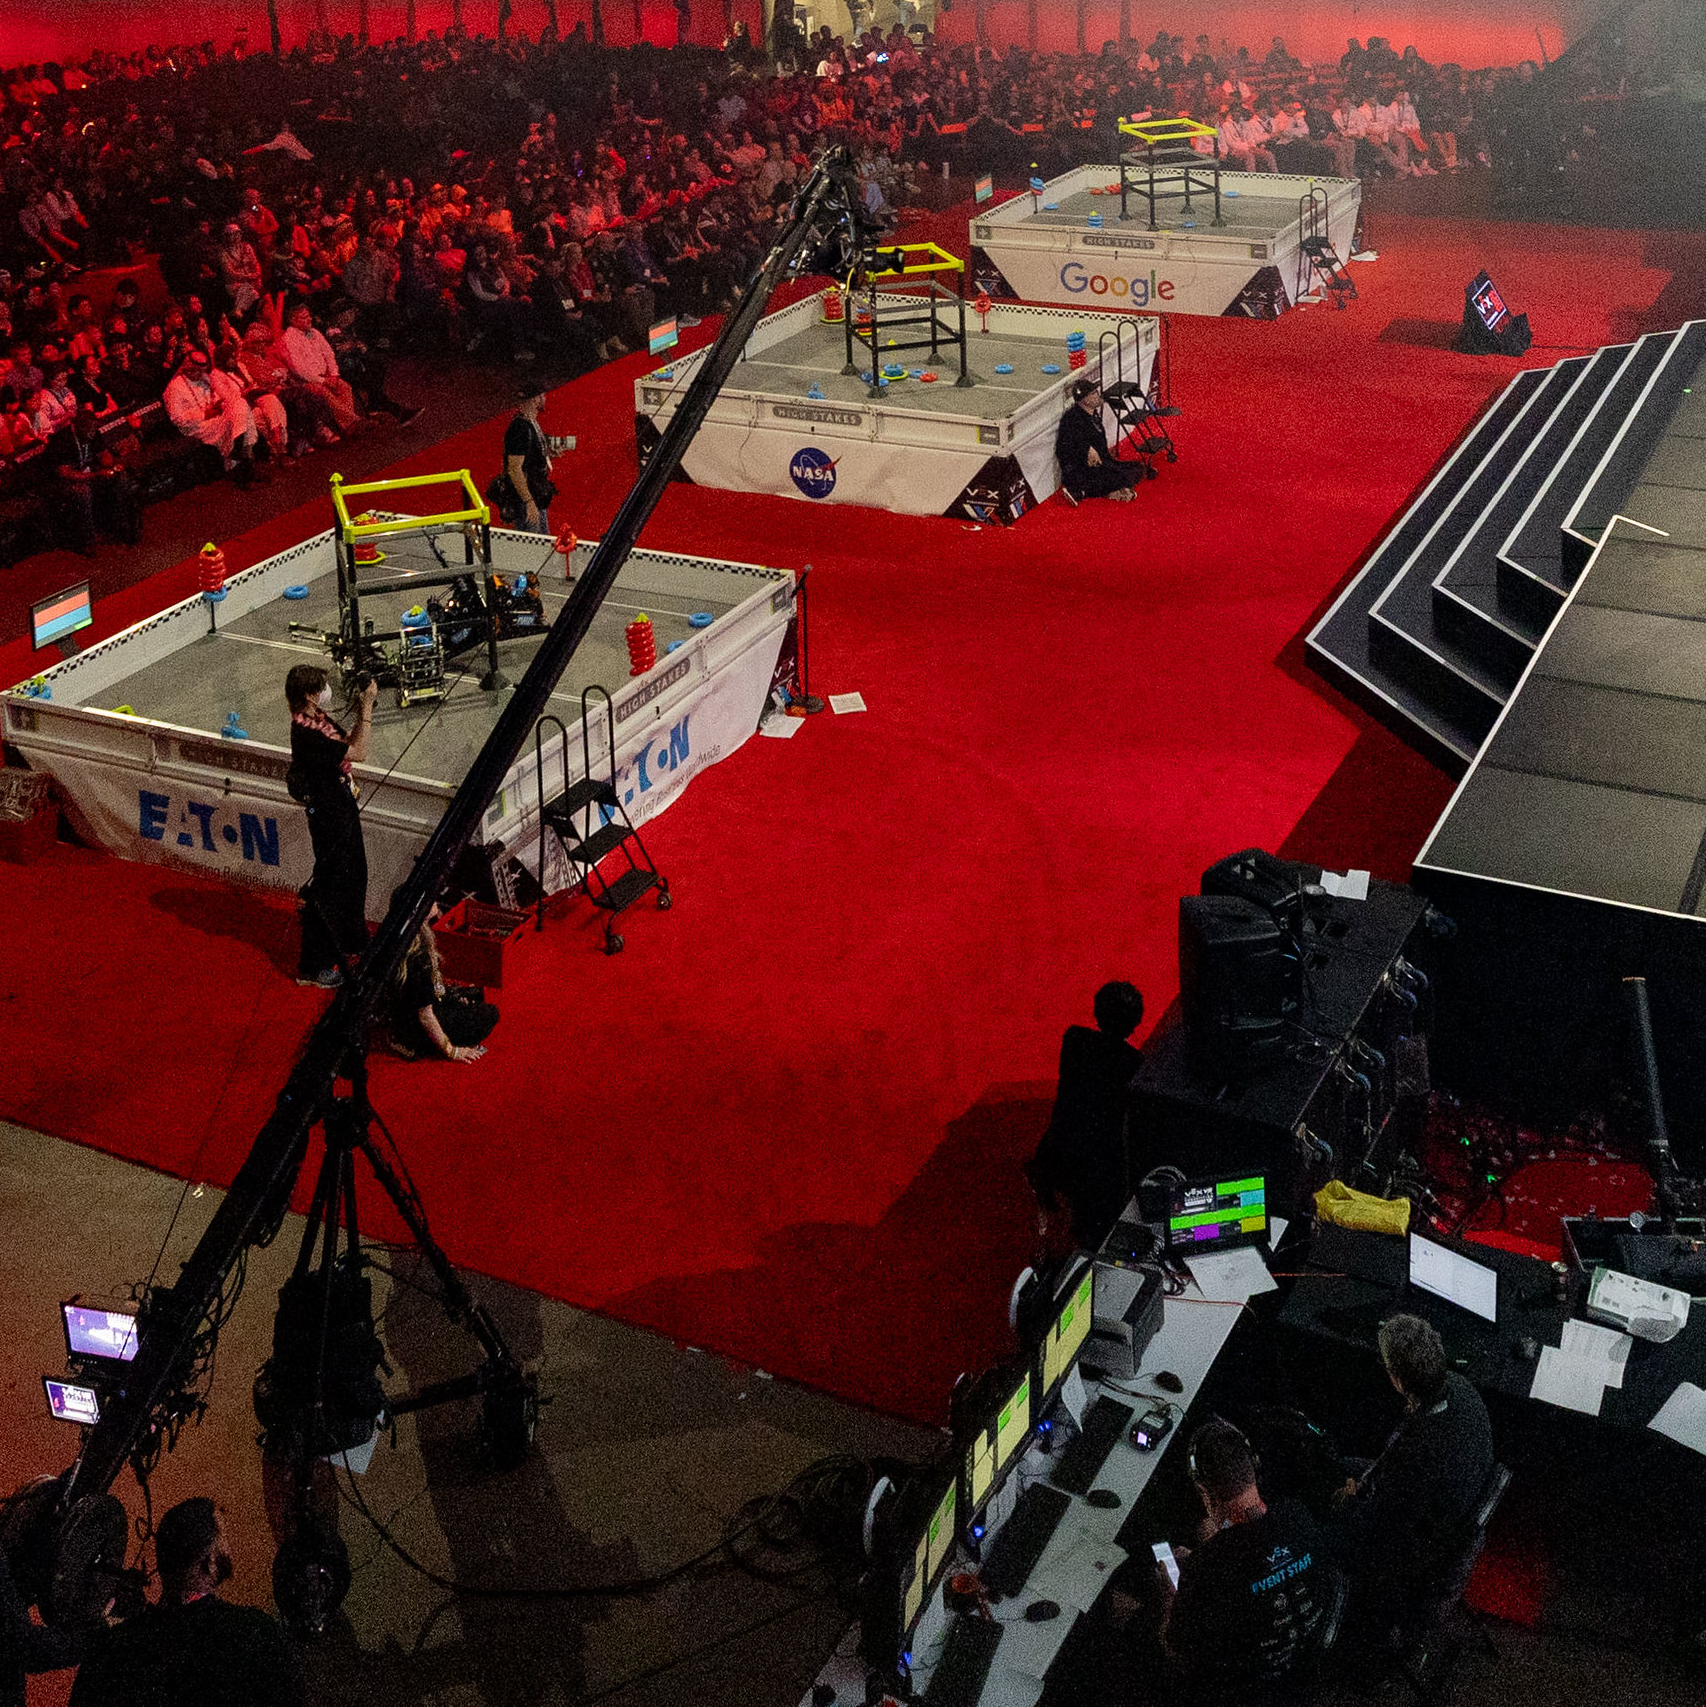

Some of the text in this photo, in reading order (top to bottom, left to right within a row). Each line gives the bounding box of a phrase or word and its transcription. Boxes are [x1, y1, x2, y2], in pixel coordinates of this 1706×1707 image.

[1060, 262, 1175, 307] Google
[778, 408, 857, 424] HIGH STAKES
[793, 465, 834, 481] NASA
[618, 696, 646, 719] HIGH
[652, 664, 687, 697] STAKES
[138, 789, 279, 867] EATON
[1250, 1552, 1312, 1595] EVENT STAFF
